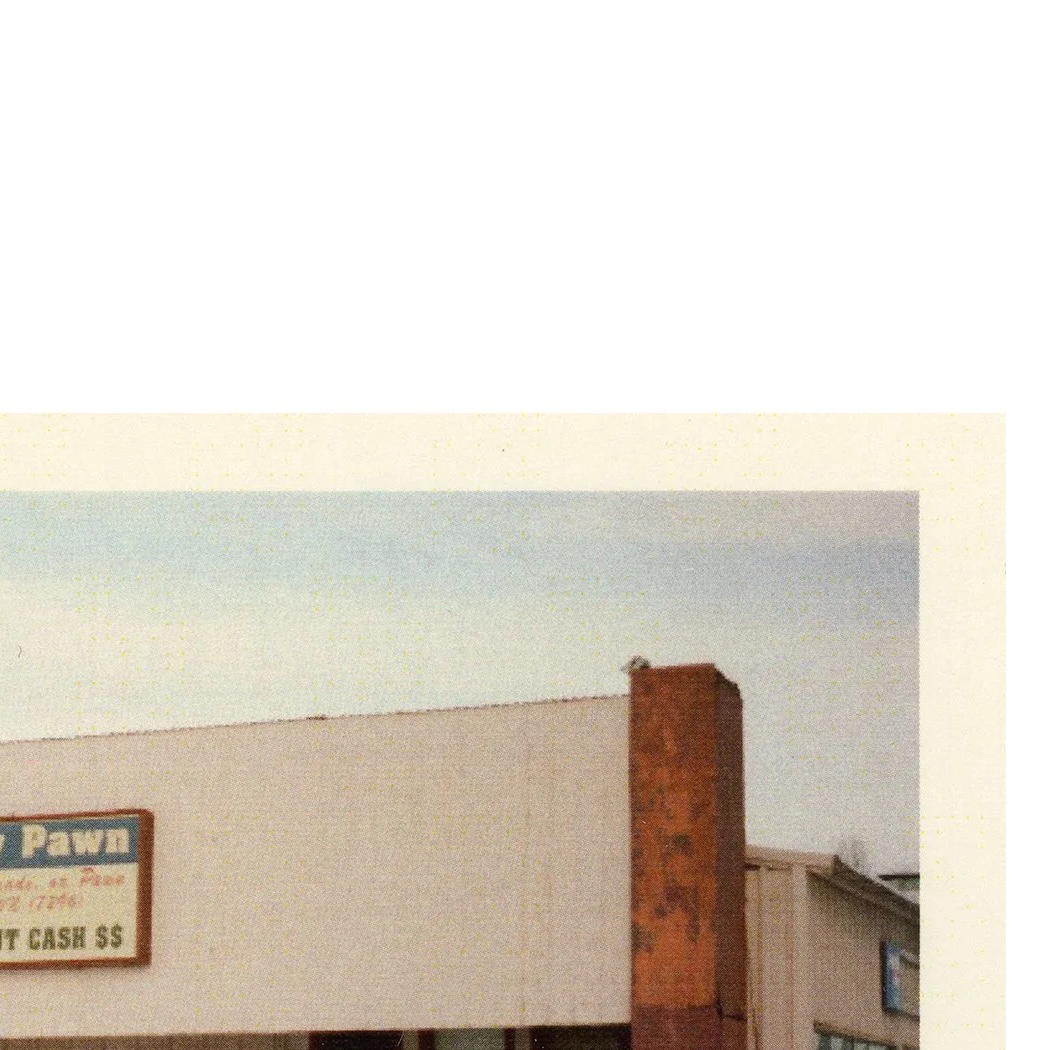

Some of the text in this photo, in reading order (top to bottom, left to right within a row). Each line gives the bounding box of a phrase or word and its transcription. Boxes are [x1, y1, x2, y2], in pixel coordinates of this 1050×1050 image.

[21, 823, 130, 859] Pawn
[28, 925, 87, 951] CASH
[94, 923, 123, 950] $$
